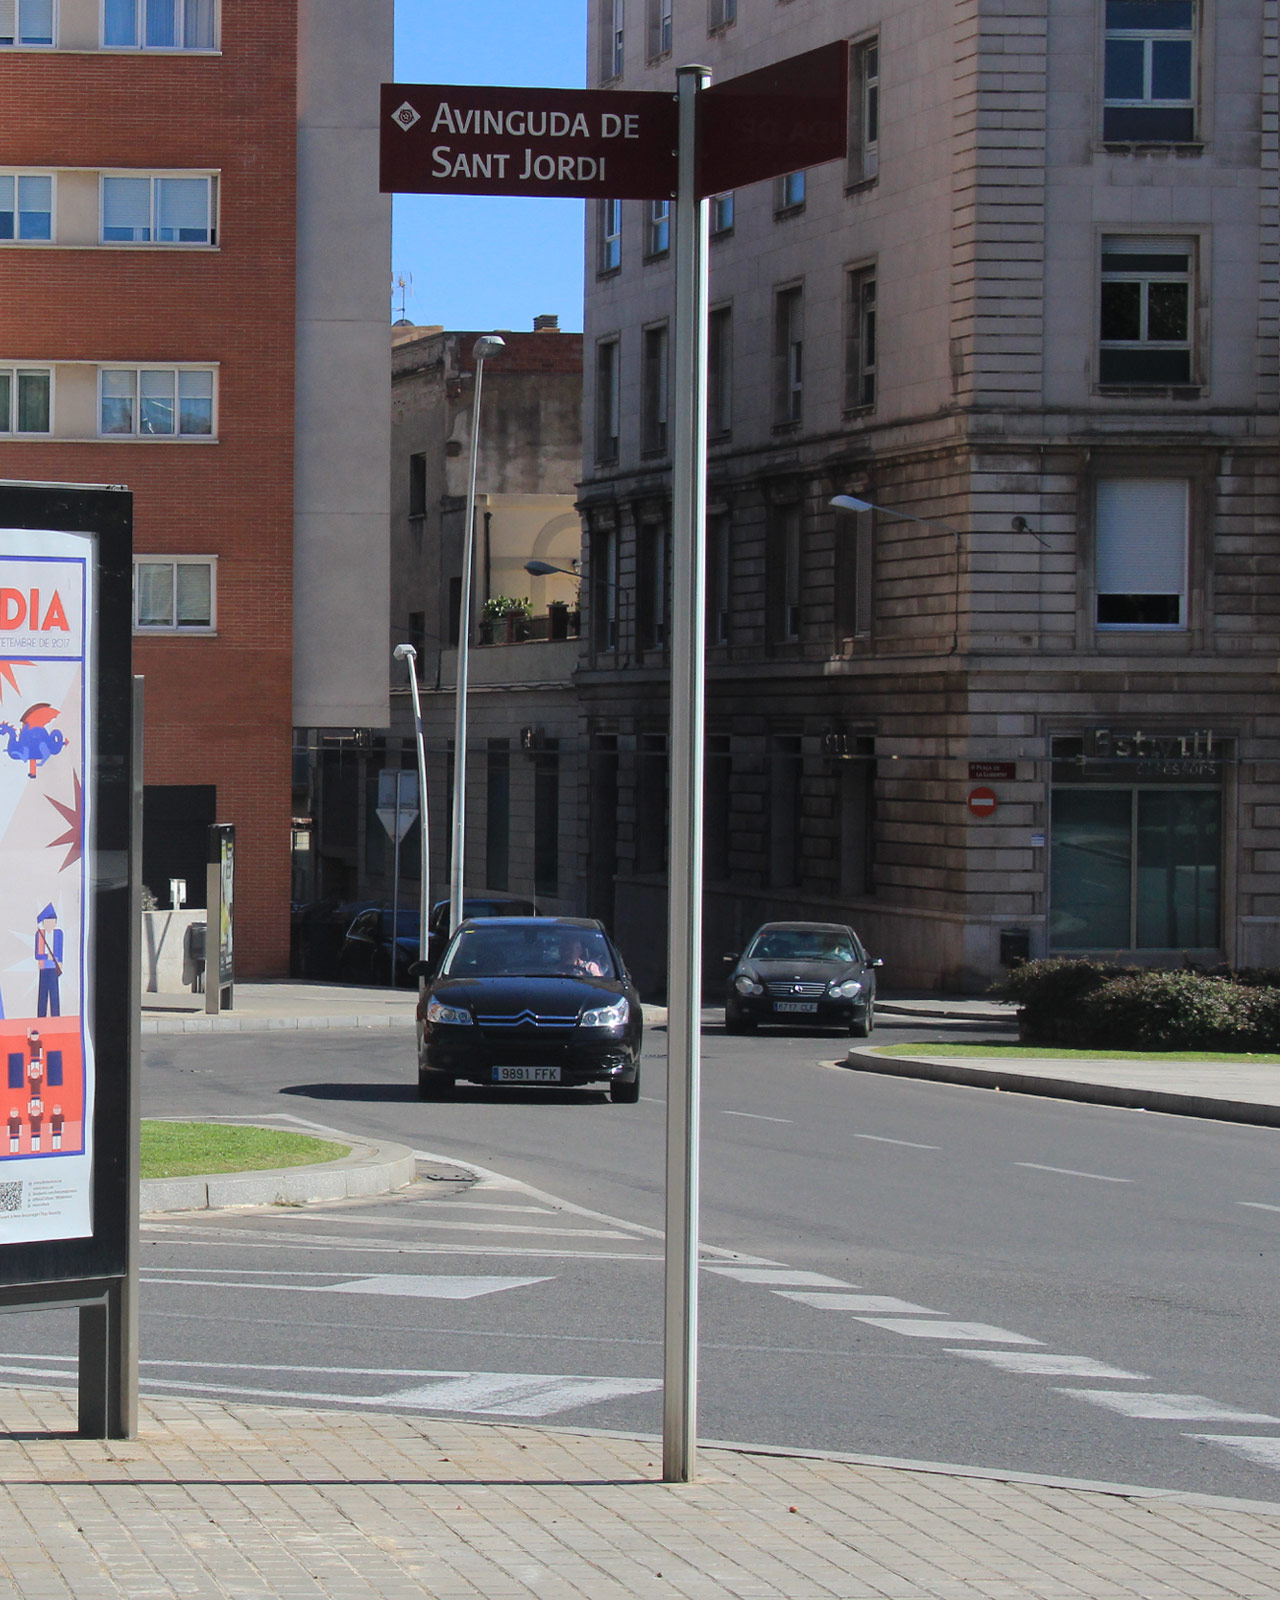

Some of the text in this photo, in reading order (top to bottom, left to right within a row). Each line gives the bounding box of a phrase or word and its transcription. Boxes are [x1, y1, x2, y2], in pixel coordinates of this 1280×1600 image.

[431, 102, 640, 139] AVINGUDA DE
[431, 145, 606, 182] SANT JORDI
[38, 637, 49, 649] DE
[51, 638, 71, 649] 2017
[501, 1067, 557, 1080] 9891 FFK
